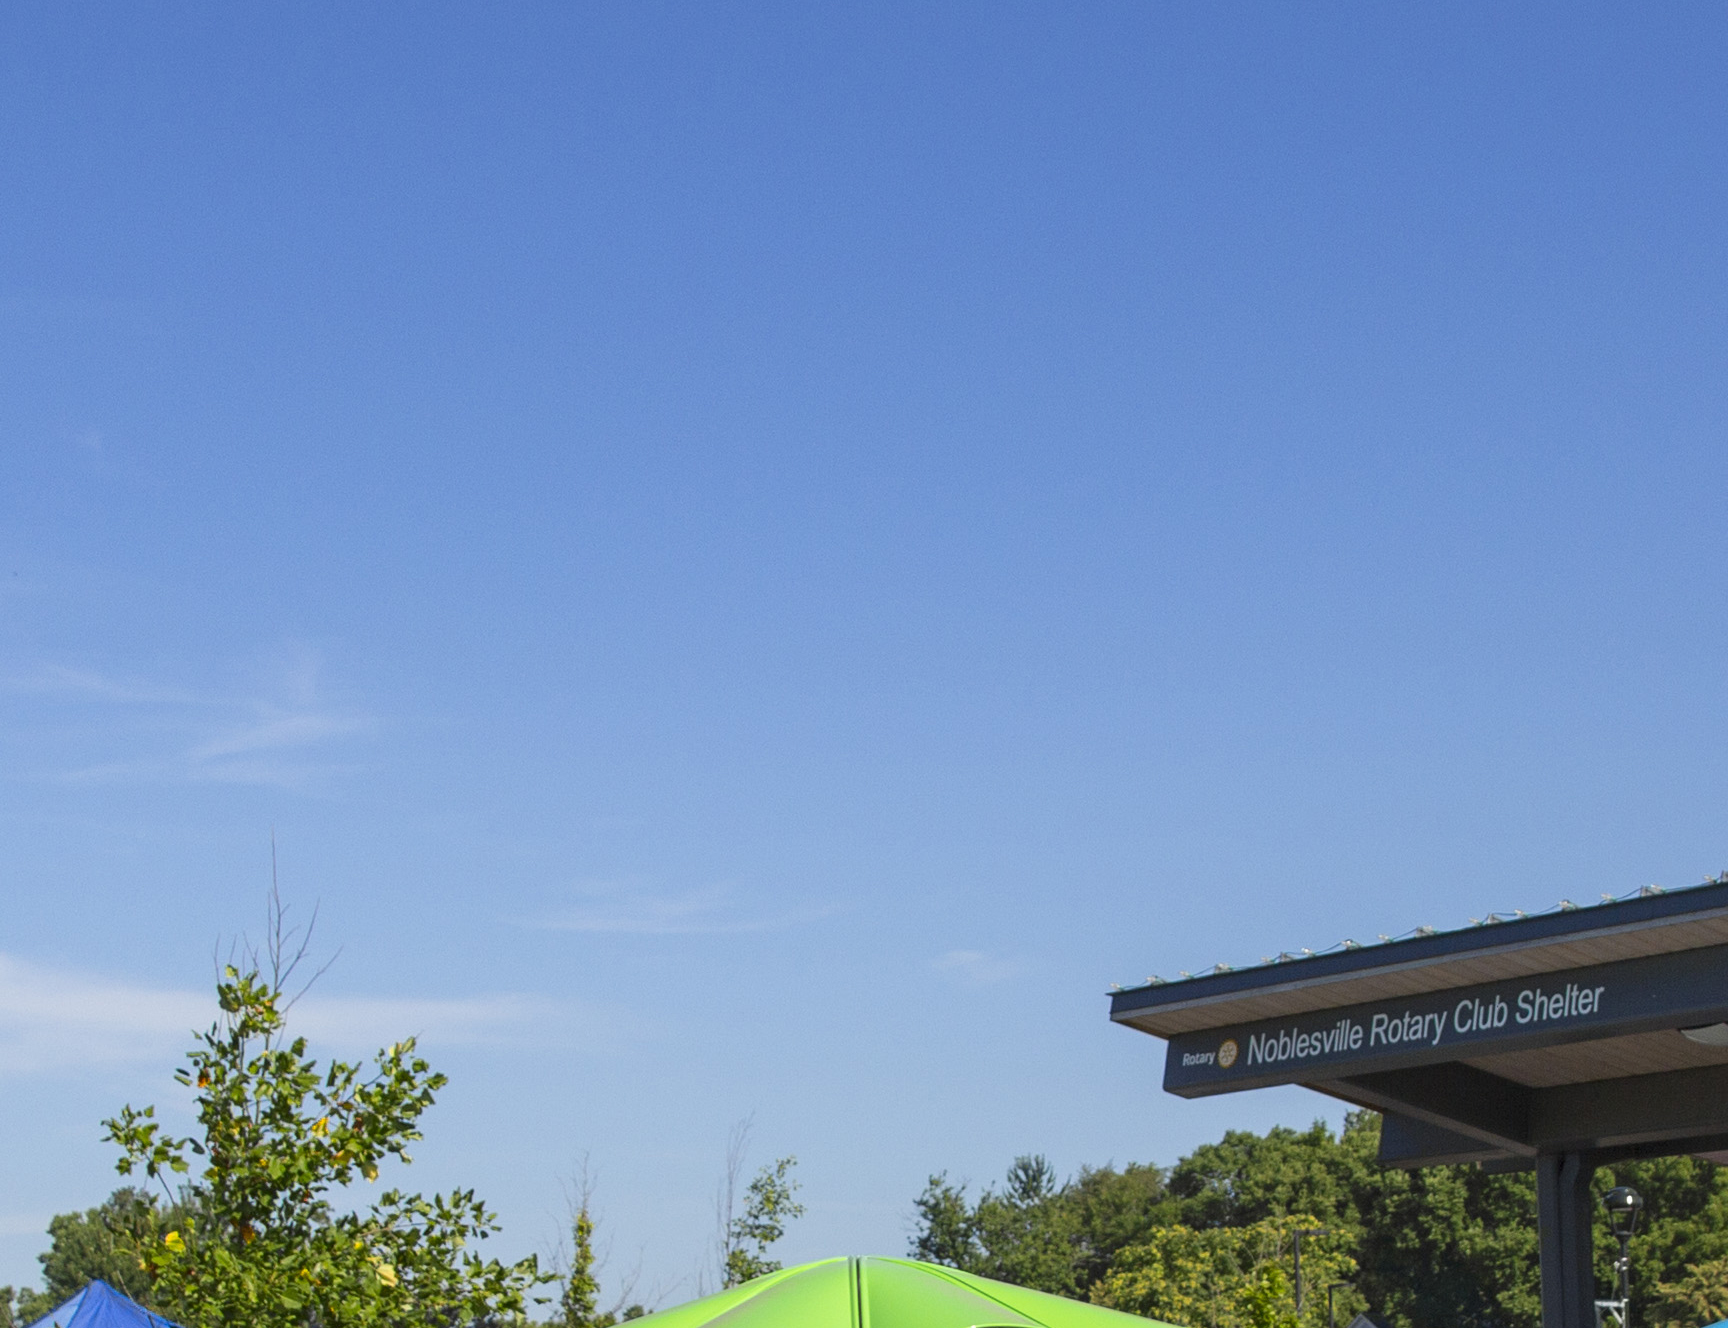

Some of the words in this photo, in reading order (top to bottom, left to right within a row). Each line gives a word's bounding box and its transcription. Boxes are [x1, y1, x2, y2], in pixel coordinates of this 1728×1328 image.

[1247, 1024, 1362, 1065] Noblesville
[1371, 1010, 1448, 1047] Rotary
[1453, 997, 1508, 1032] Club
[1515, 984, 1605, 1024] Shelter
[1182, 1051, 1215, 1066] Rotary
